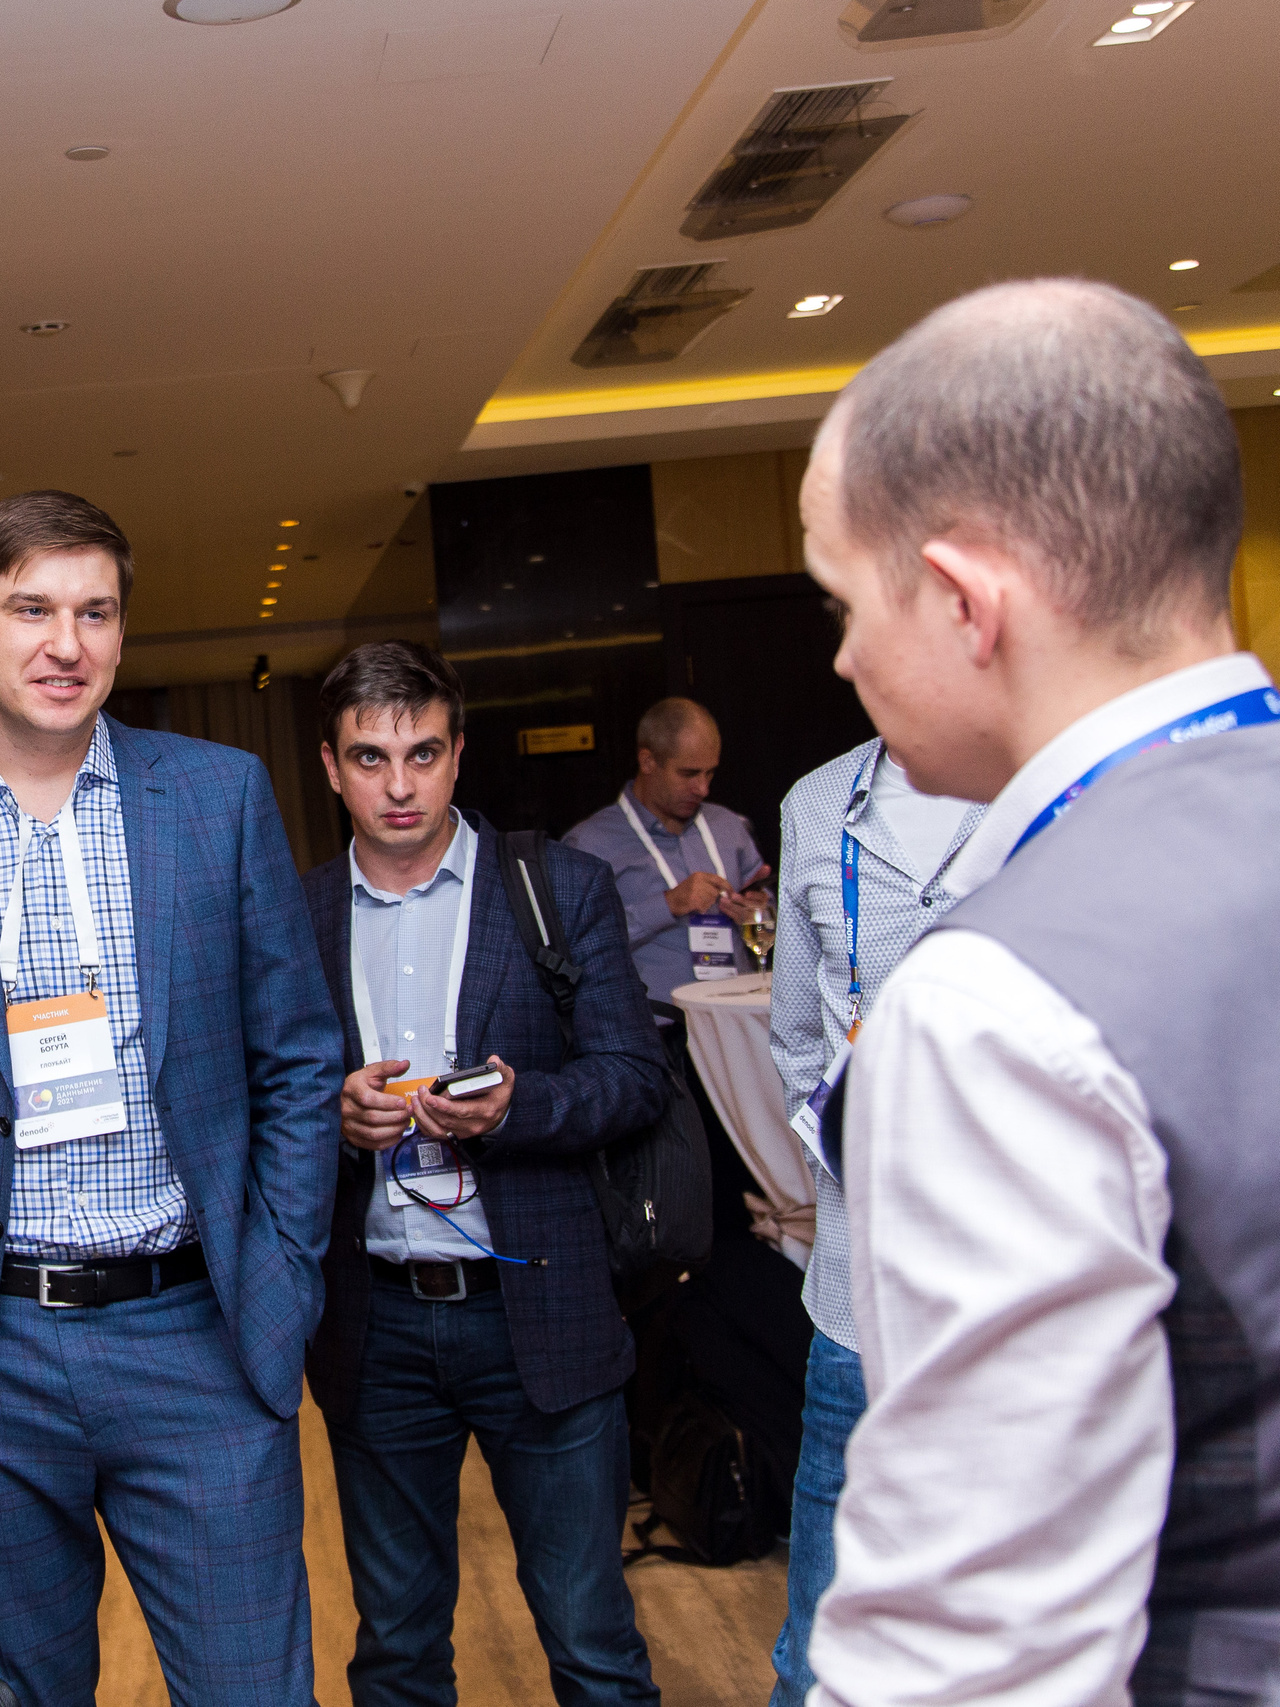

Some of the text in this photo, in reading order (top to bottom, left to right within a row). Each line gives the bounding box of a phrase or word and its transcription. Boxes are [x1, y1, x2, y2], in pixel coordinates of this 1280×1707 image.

[32, 1008, 70, 1022] УЧАСТНИК
[39, 1033, 67, 1045] СЕРГЕЙ
[40, 1042, 70, 1054] БОГУТА
[40, 1058, 72, 1069] ГЛОУБАЙТ
[55, 1078, 104, 1092] УПРАВЛЕНИЕ
[56, 1086, 96, 1100] ДАННЫМИ
[57, 1098, 74, 1106] 2021
[799, 1114, 816, 1135] denodo
[19, 1125, 49, 1138] denodo
